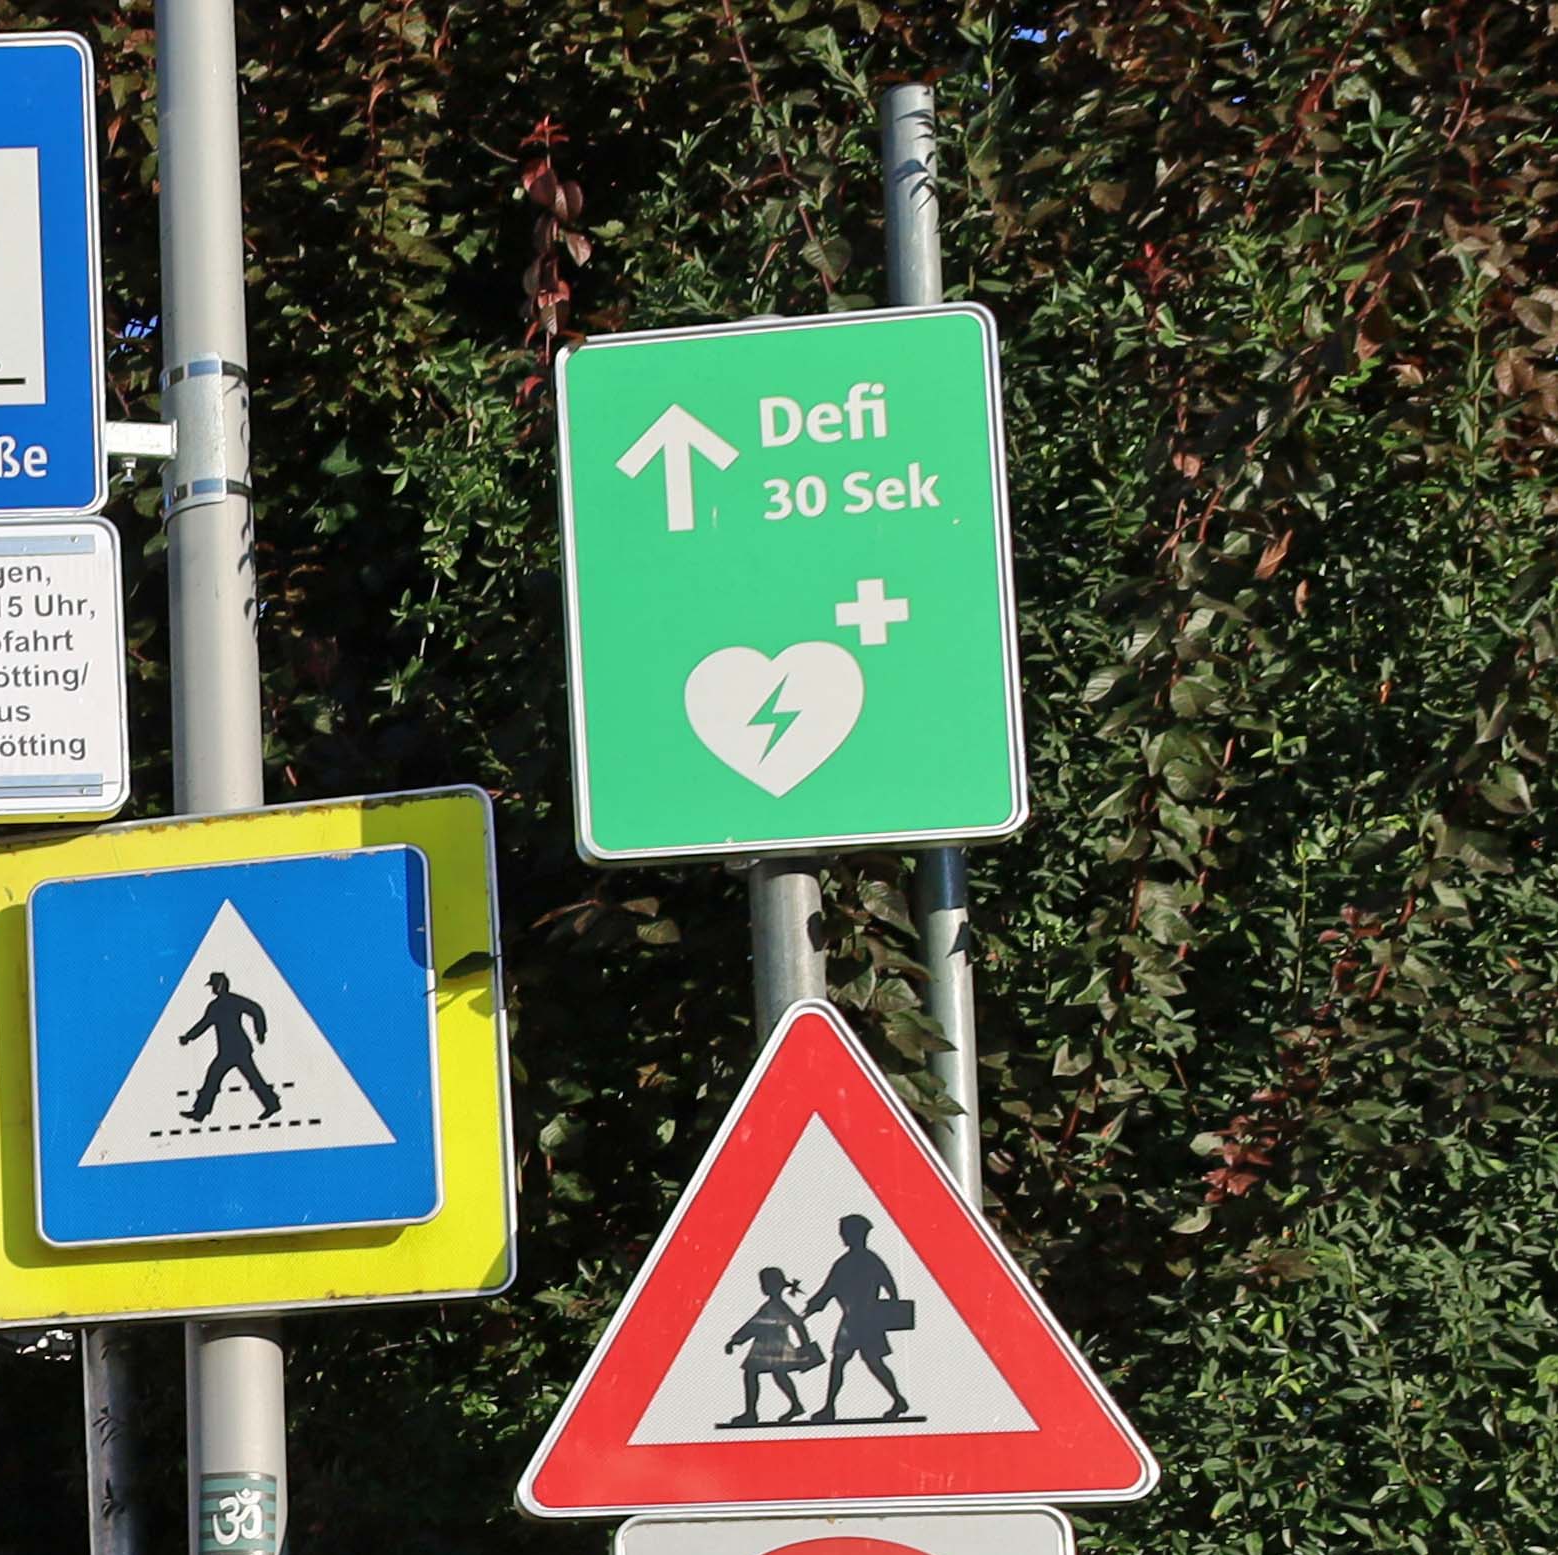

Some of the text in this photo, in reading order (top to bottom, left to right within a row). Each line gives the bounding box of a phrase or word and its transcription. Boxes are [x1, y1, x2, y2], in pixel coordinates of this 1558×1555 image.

[758, 382, 888, 448] Defi
[762, 462, 940, 522] 30 Sek
[33, 593, 97, 621] Uhr,
